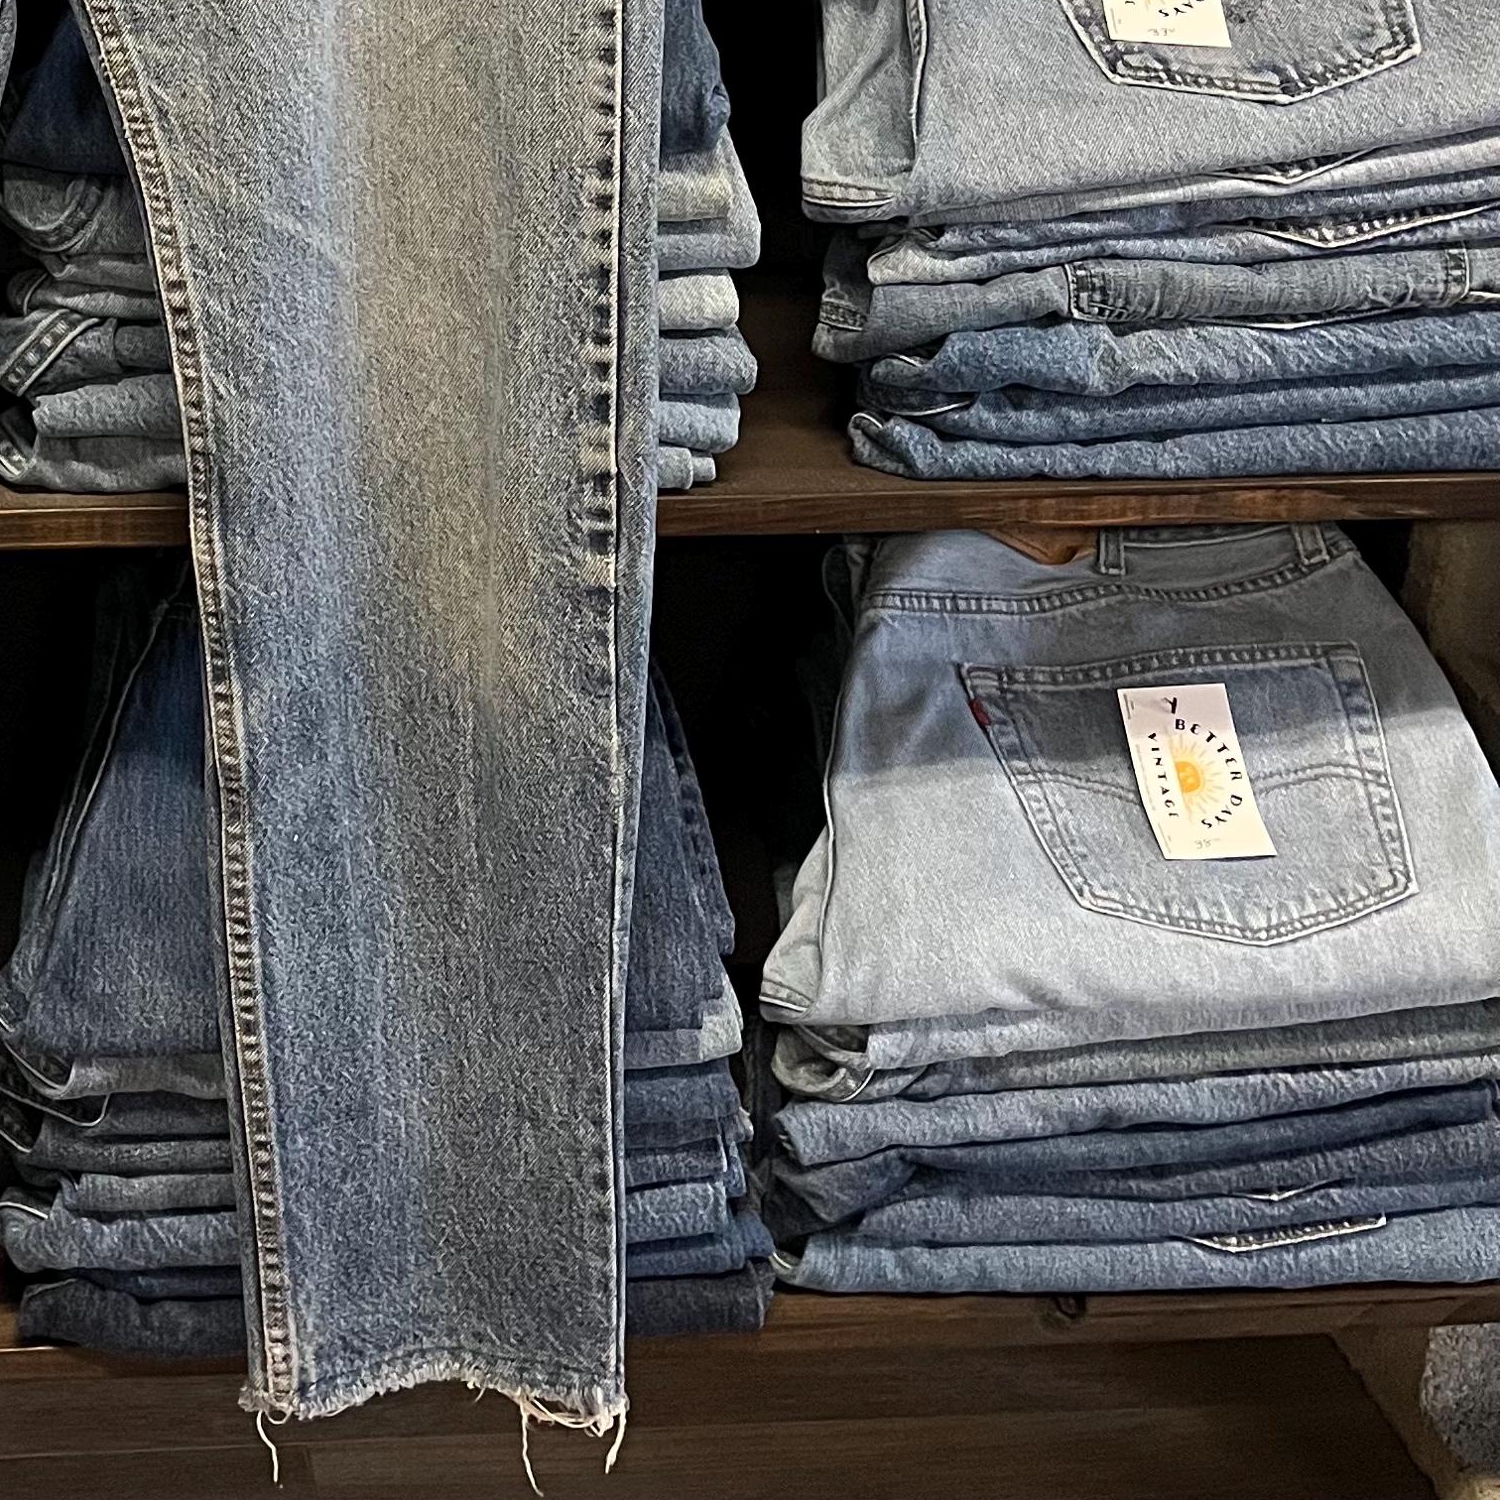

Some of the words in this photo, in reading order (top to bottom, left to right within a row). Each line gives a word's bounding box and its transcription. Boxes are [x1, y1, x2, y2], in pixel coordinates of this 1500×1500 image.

[1147, 731, 1179, 818] VINTAGE
[1174, 718, 1243, 781] BETTER
[1201, 793, 1243, 829] DAYS
